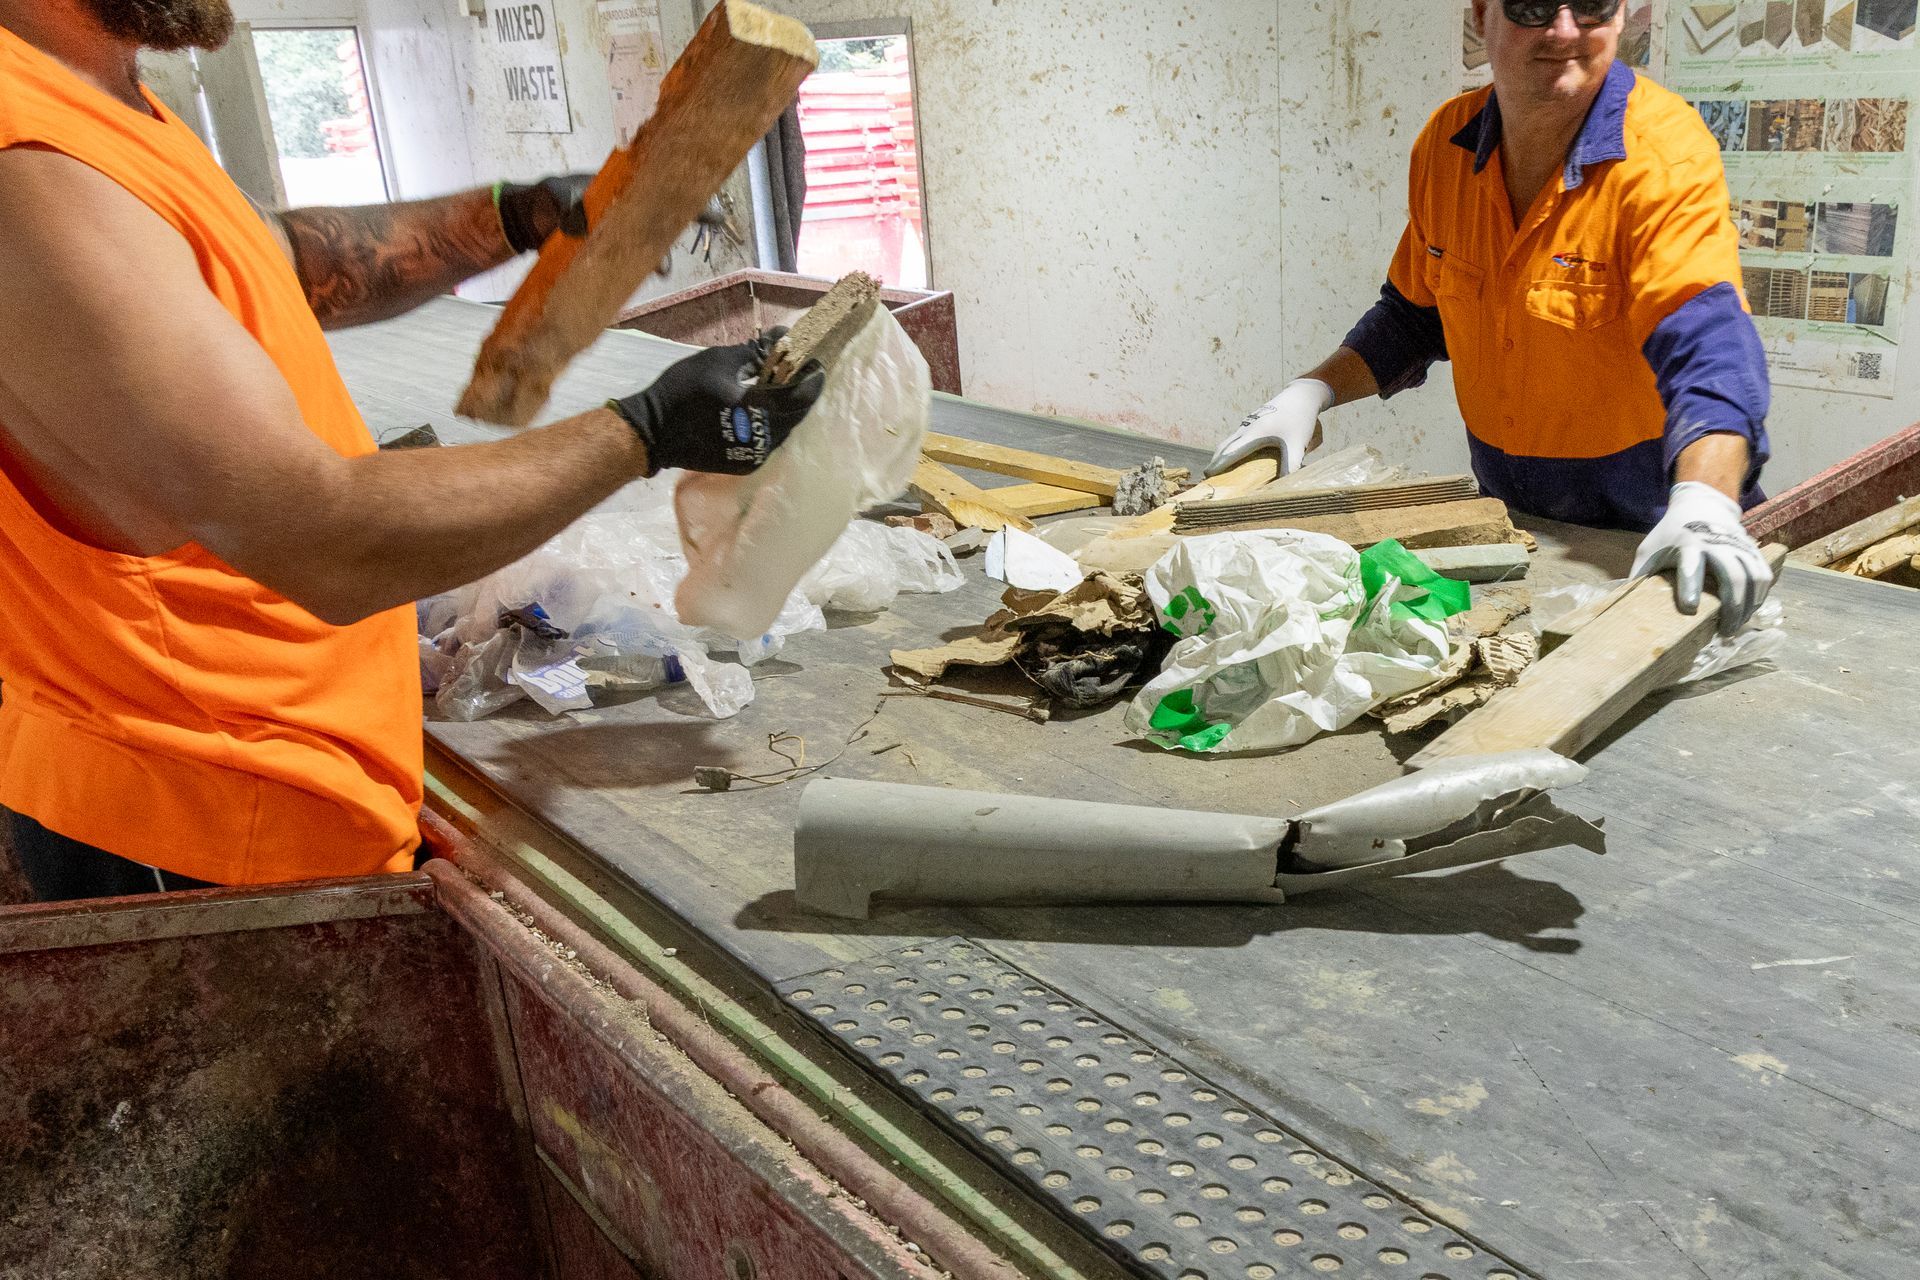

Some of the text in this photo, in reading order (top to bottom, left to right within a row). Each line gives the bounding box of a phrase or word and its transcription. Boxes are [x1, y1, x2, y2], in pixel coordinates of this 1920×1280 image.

[495, 3, 545, 43] MIXED
[503, 65, 558, 101] WASTE
[1678, 86, 1698, 94] Frame
[1699, 85, 1711, 93] and
